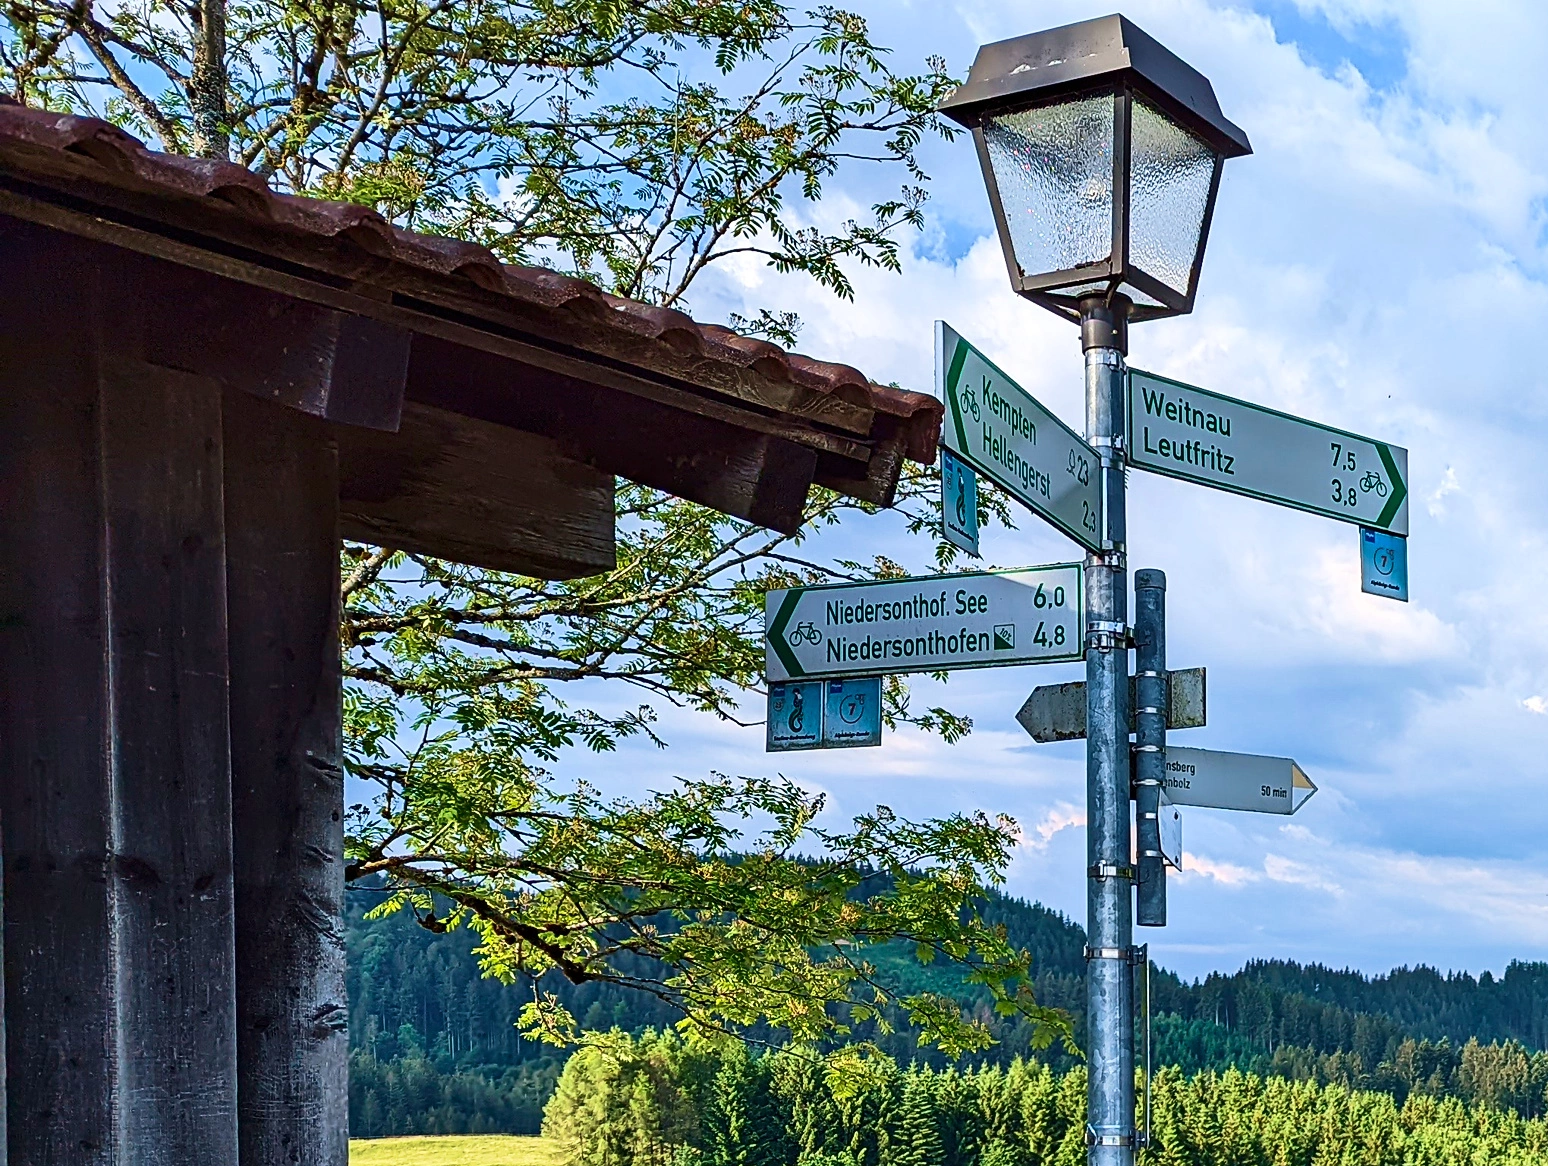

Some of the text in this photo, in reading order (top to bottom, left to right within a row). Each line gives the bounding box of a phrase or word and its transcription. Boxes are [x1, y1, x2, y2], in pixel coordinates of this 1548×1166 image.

[982, 375, 1037, 445] Kempten
[1142, 387, 1231, 437] Weitnau
[982, 422, 1051, 500] Hellengerst
[1143, 427, 1235, 475] Leutfritz
[1331, 442, 1356, 472] 7,5
[1077, 455, 1089, 487] 23
[1331, 478, 1357, 507] 3,8
[1082, 500, 1096, 533] 2,3
[826, 582, 1065, 625] Niedersonthof. See 6,0
[827, 626, 990, 663] Niedersonthofen
[1032, 621, 1065, 649] 4,8
[848, 703, 856, 716] 7
[1261, 785, 1287, 798] 50 min
